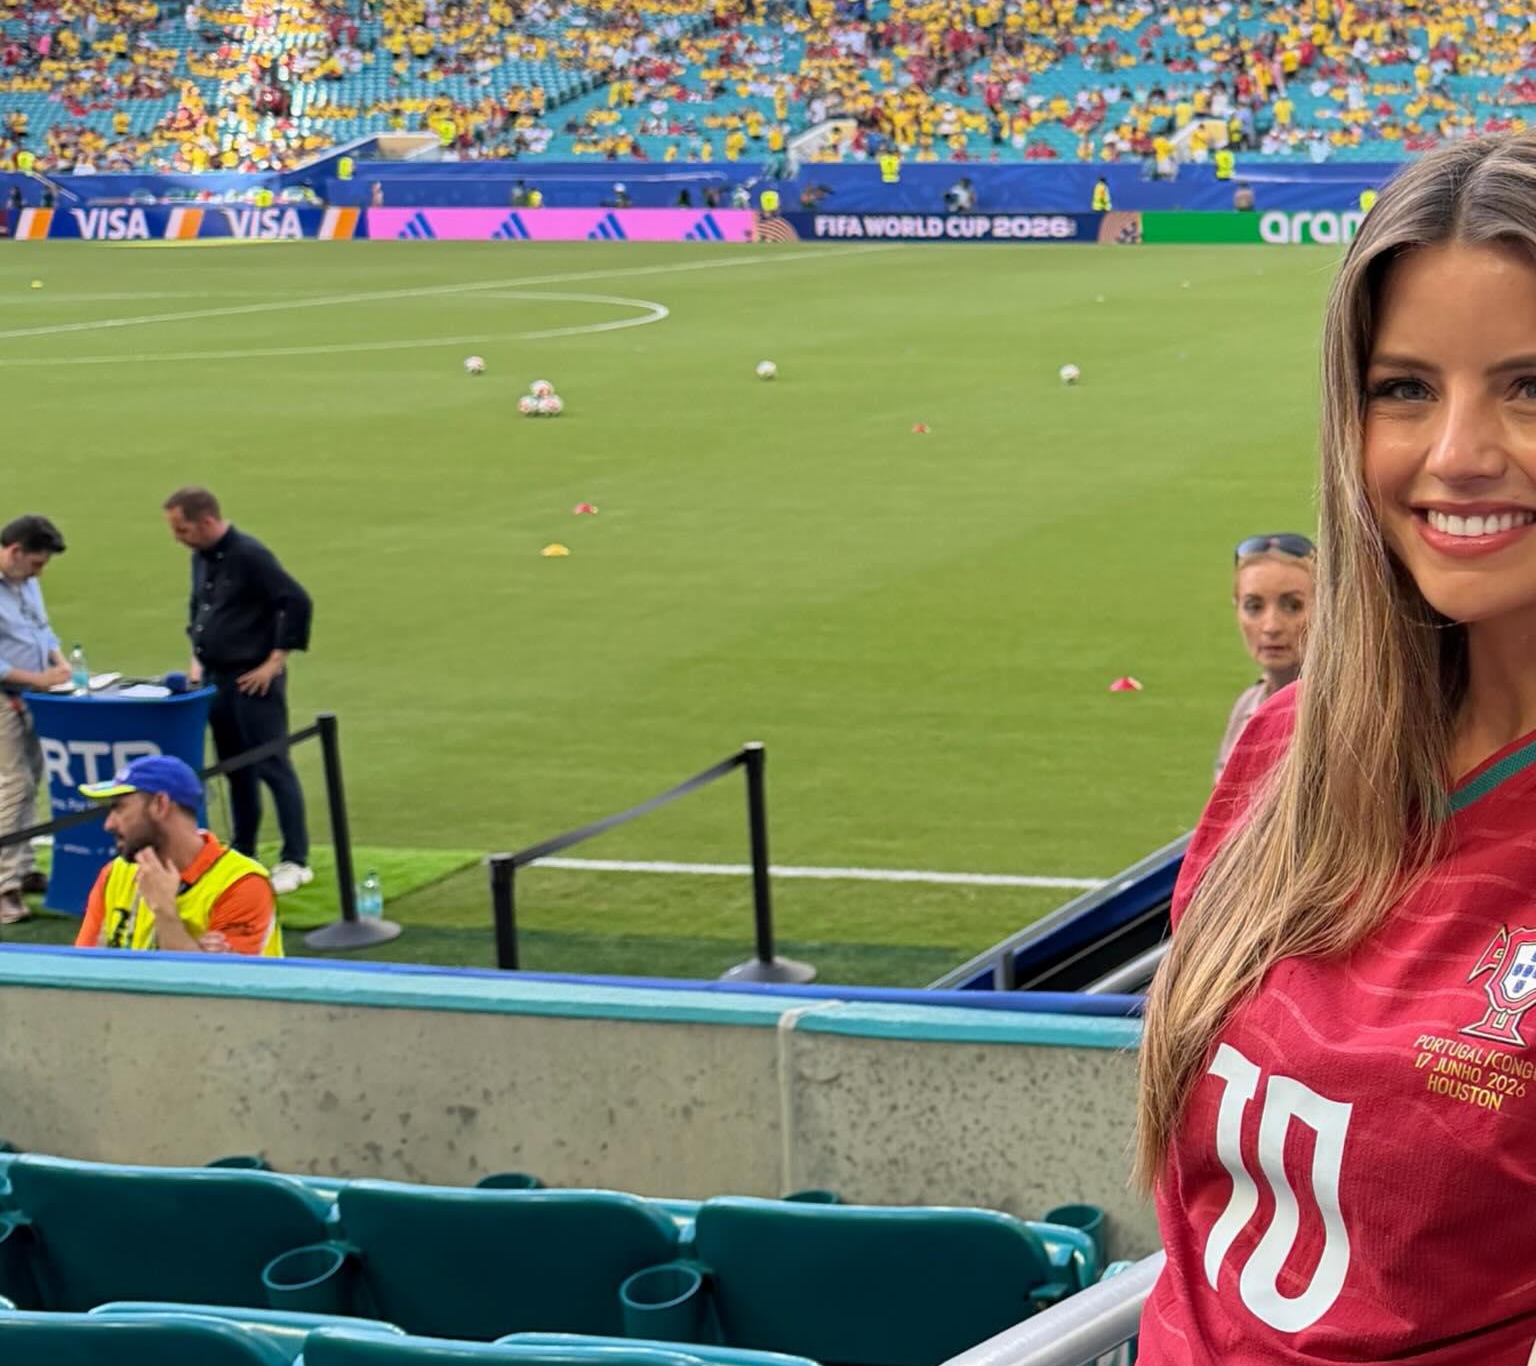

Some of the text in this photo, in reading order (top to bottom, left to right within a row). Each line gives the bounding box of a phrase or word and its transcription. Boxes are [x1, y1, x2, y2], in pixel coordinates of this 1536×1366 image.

[71, 207, 149, 240] VISA
[222, 207, 304, 240] VISA
[814, 215, 1070, 238] FIFA WORLD CUP 2026
[1414, 1052, 1527, 1099] 17 JUNHO 2026
[1426, 1073, 1505, 1112] HOUSTON
[1207, 1042, 1353, 1333] 10
